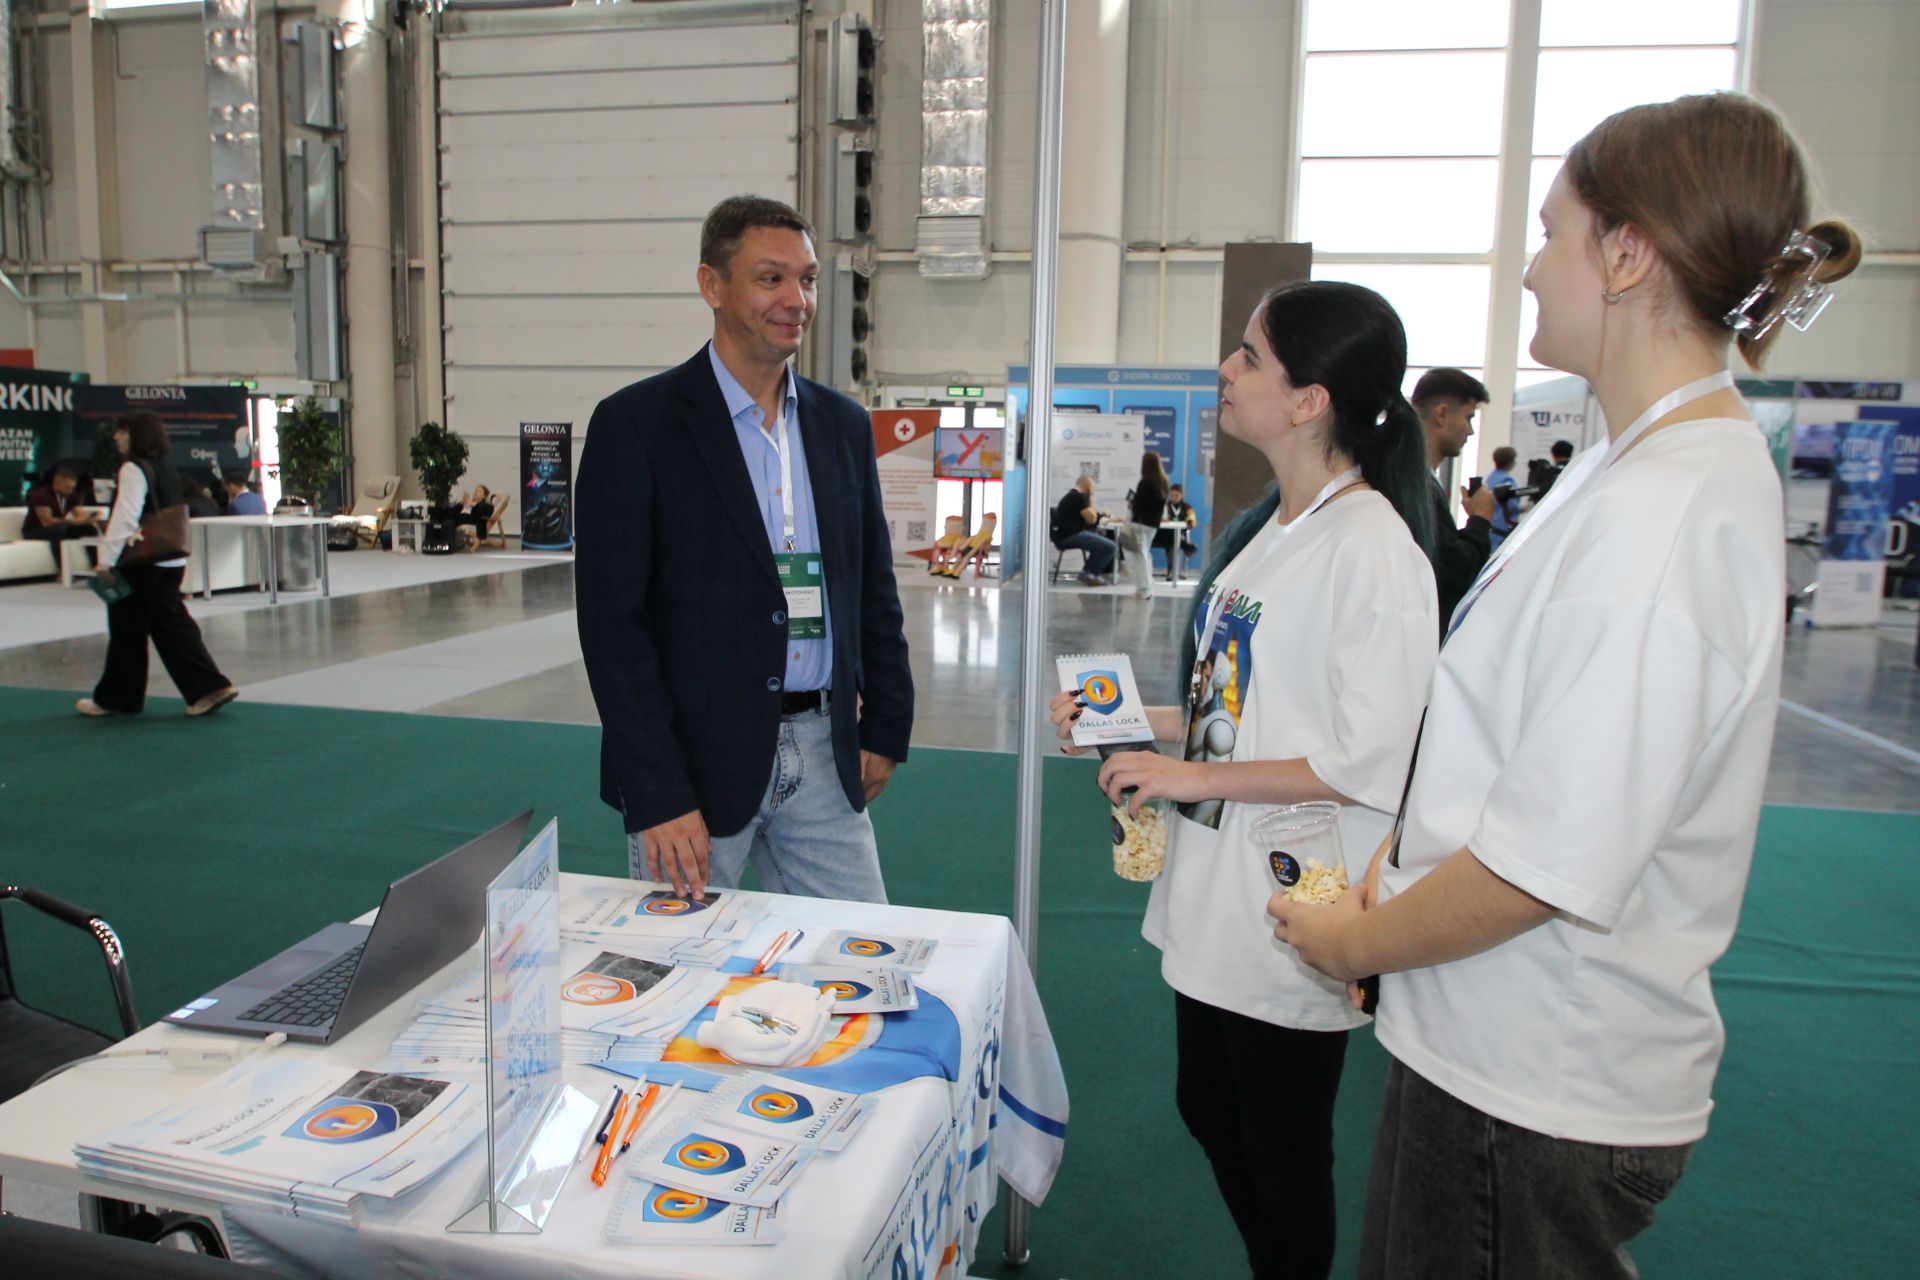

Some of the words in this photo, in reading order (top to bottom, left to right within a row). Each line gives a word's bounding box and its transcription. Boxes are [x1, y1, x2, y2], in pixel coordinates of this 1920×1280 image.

[523, 425, 566, 434] GELONYA
[1078, 719, 1114, 729] DALLAS
[1115, 717, 1141, 726] LOCK
[533, 862, 551, 892] LOCK
[804, 1114, 832, 1139] DALLAS
[825, 1096, 847, 1114] LOCK
[734, 1164, 765, 1193] DALLAS
[760, 1146, 783, 1165] LOCK
[733, 1205, 749, 1233] DALLA
